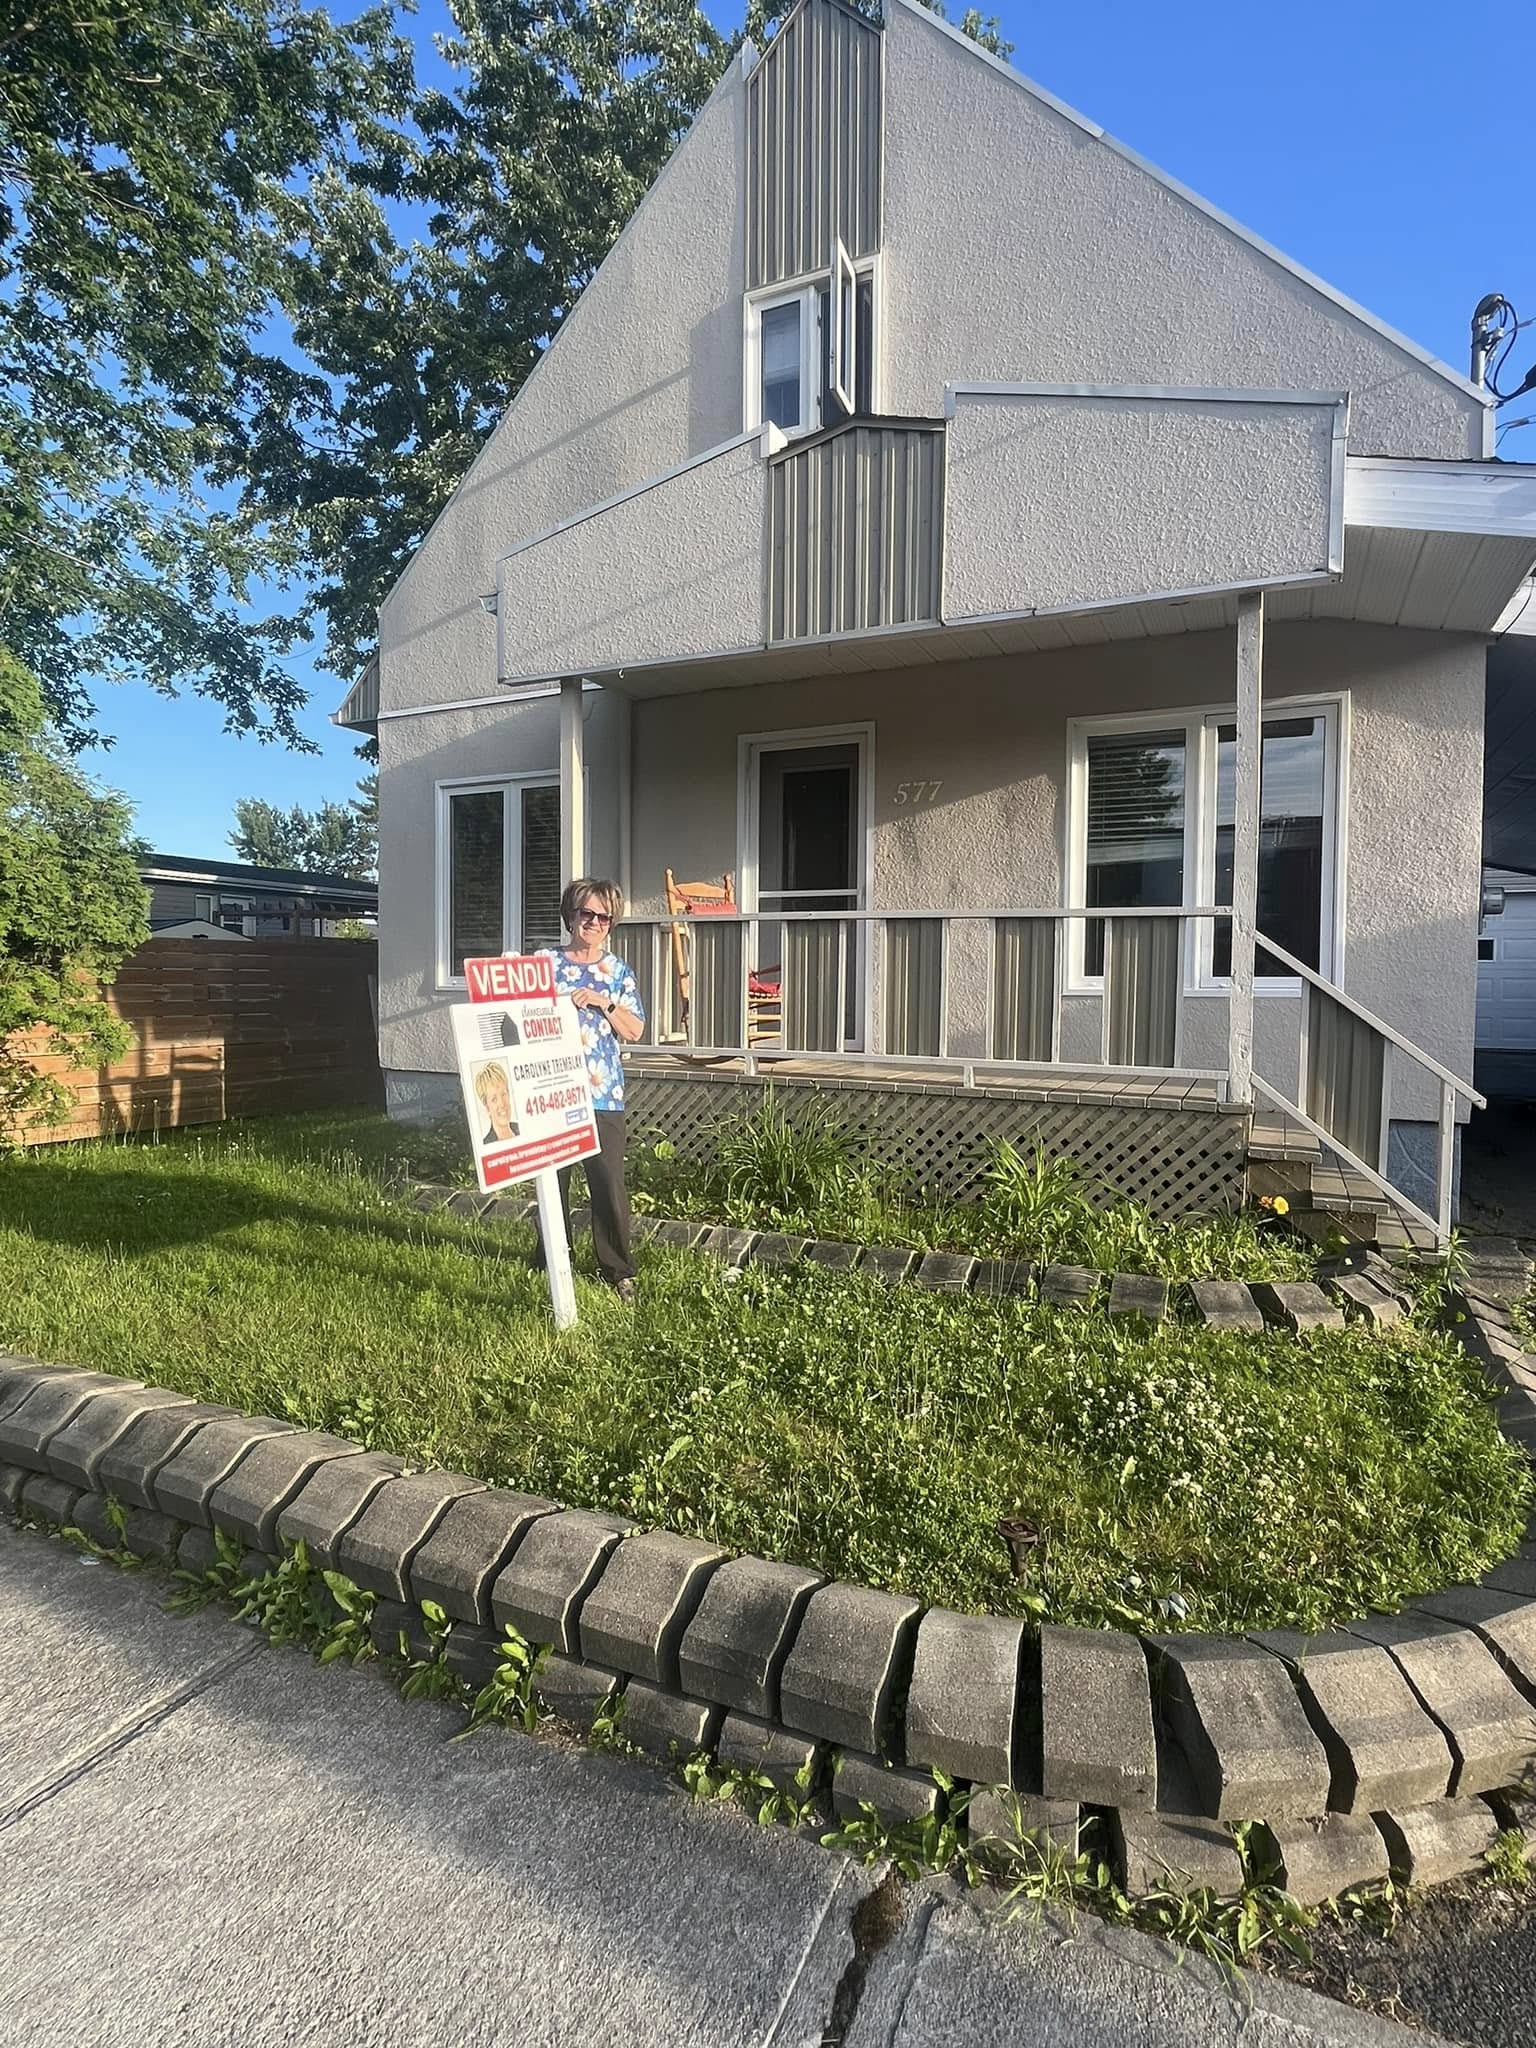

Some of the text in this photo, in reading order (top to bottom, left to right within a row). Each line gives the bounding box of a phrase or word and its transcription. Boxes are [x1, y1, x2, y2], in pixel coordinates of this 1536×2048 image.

[893, 781, 943, 805] 577
[472, 962, 551, 996] VENDU
[523, 1016, 563, 1039] CONTACT
[513, 1059, 552, 1081] CAROLYNE
[551, 1055, 583, 1074] TREMBLAY
